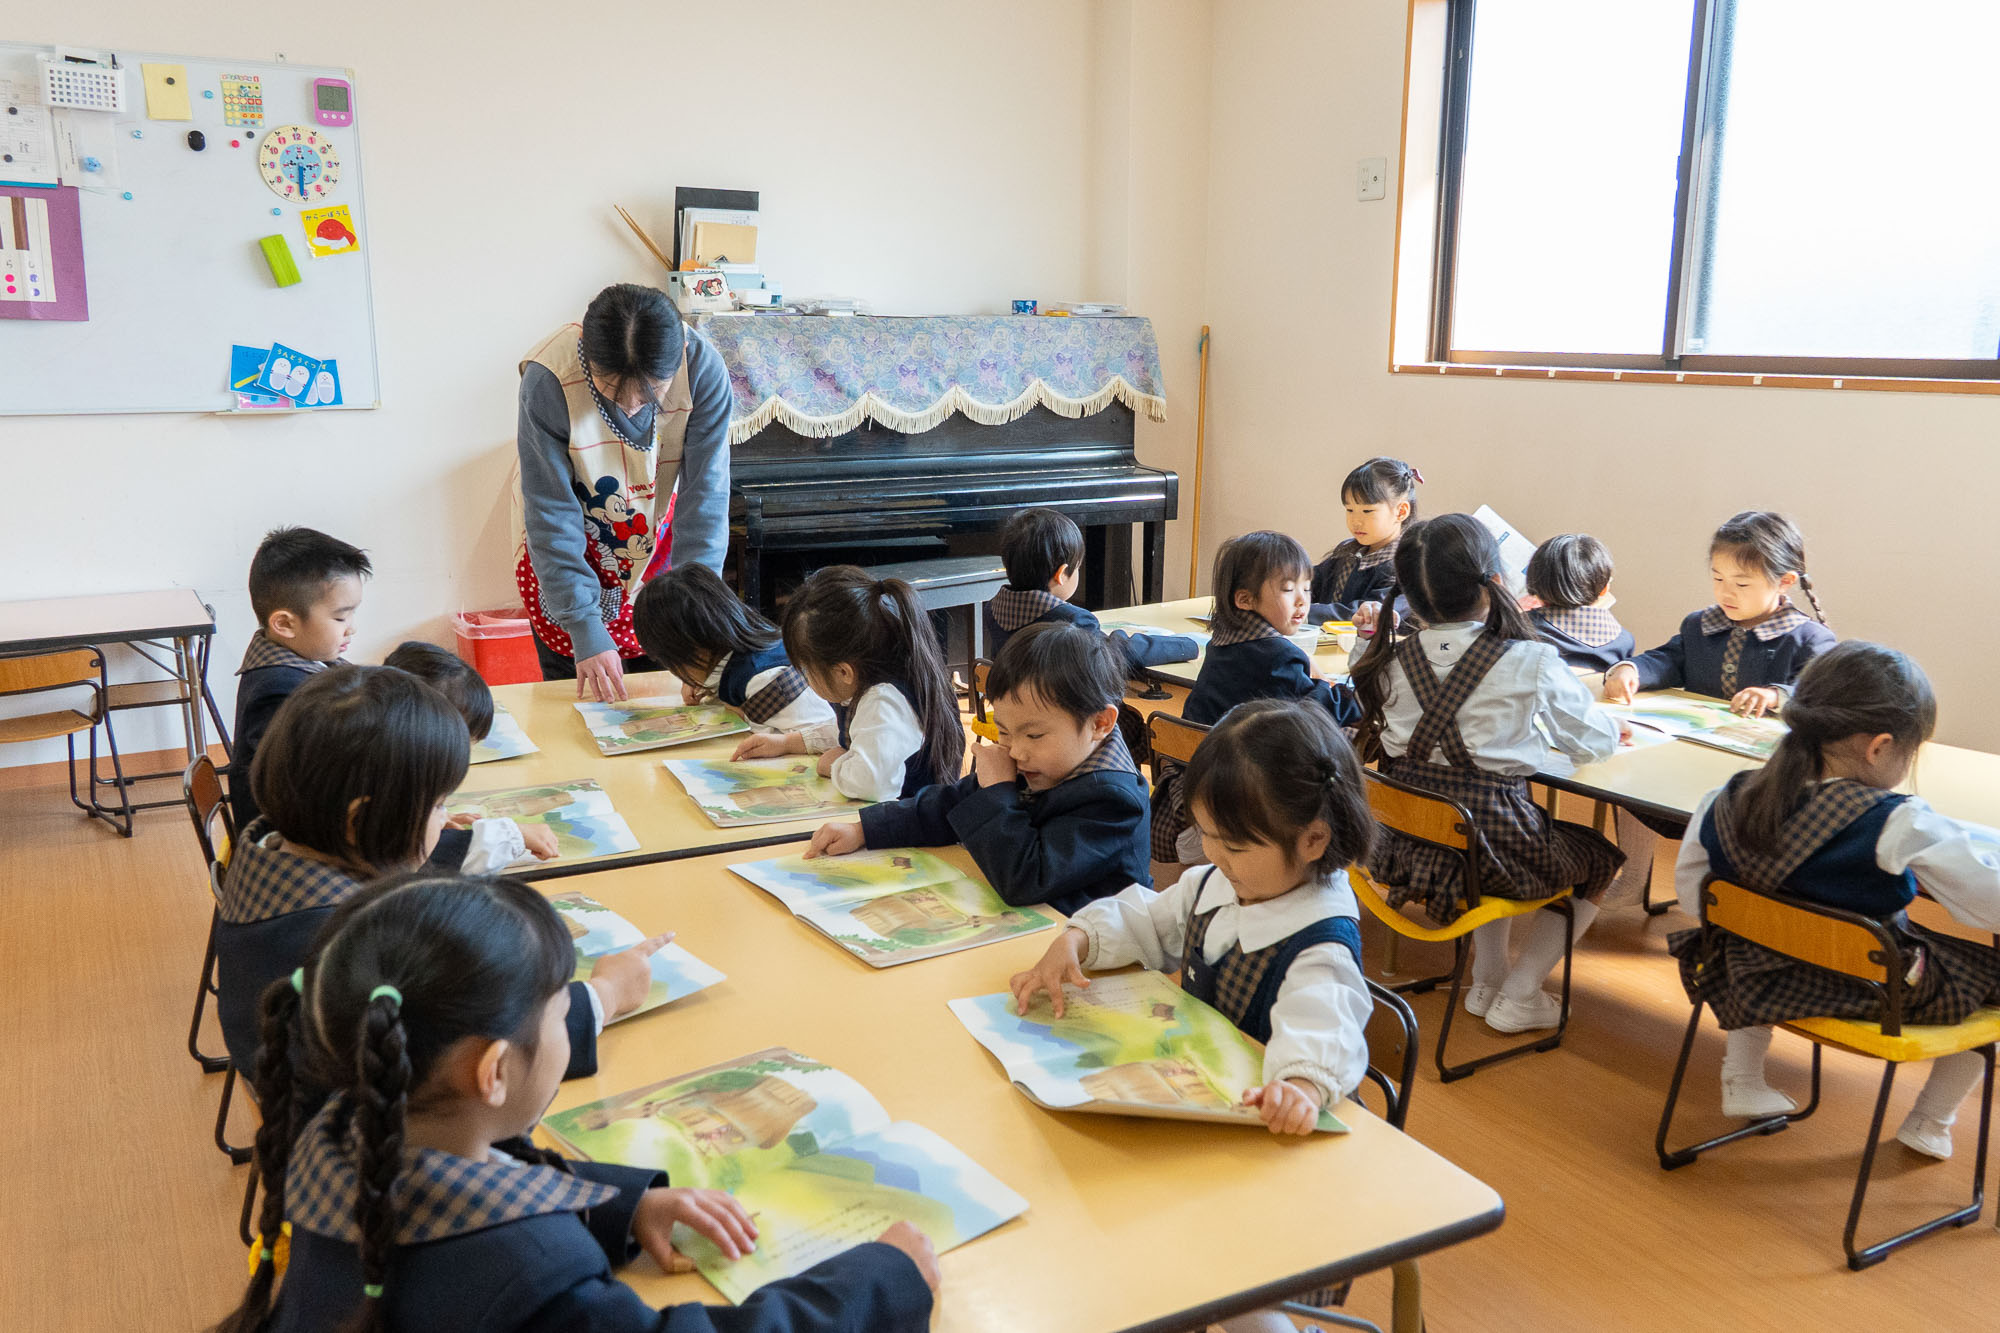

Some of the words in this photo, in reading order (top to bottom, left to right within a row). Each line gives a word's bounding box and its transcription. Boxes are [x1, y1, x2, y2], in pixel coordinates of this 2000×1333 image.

[278, 136, 286, 145] 11
[292, 133, 301, 141] 12
[321, 146, 327, 154] 2
[269, 161, 275, 169] 9
[287, 185, 293, 193] 7
[316, 184, 322, 192] 5
[628, 484, 649, 493] You
